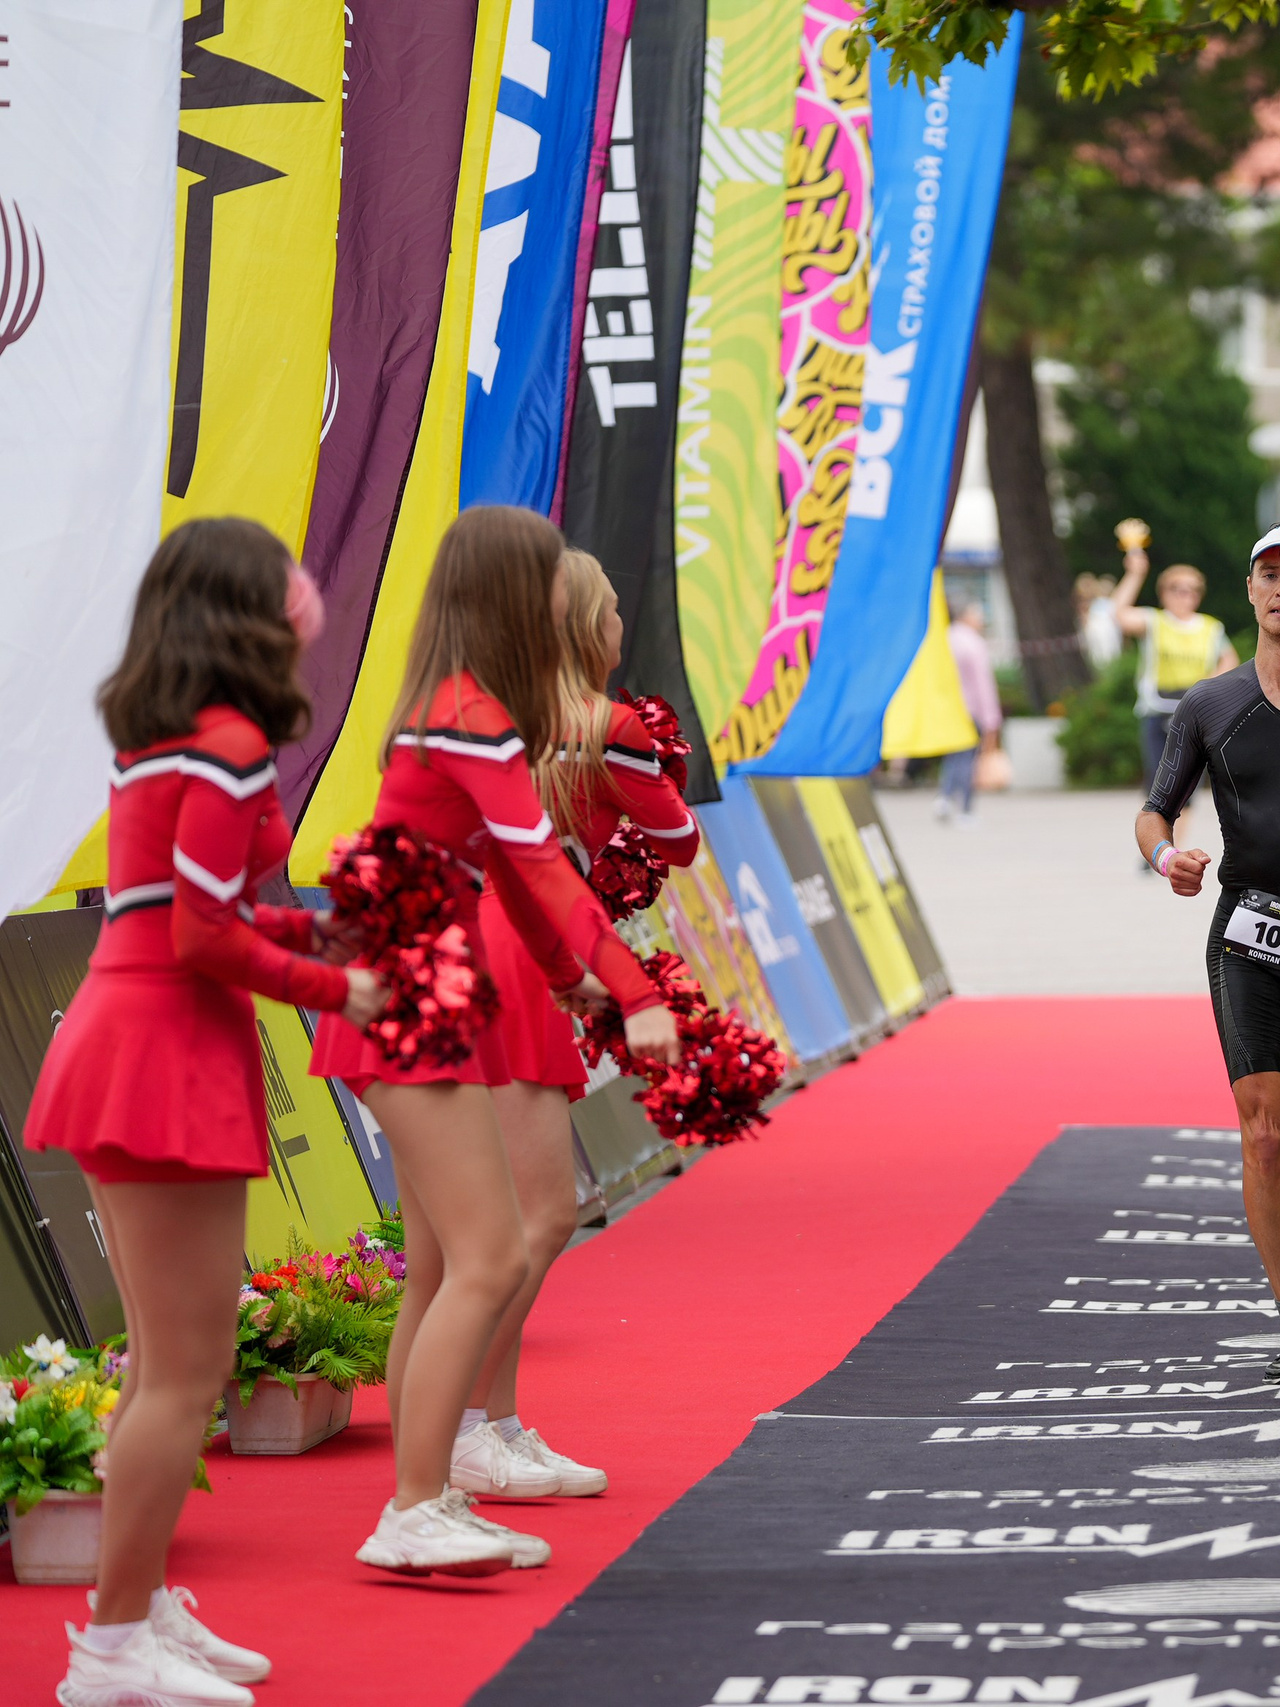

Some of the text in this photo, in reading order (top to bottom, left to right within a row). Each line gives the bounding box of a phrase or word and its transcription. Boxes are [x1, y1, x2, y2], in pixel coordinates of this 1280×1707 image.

[898, 156, 943, 338] СТРАХОВОЙ
[675, 295, 711, 568] VITAMIN
[1048, 1299, 1279, 1311] IRON
[970, 1381, 1229, 1401] IRON
[930, 1420, 1203, 1438] IRON
[838, 1523, 1152, 1549] IRON
[711, 1675, 1081, 1704] IRON
